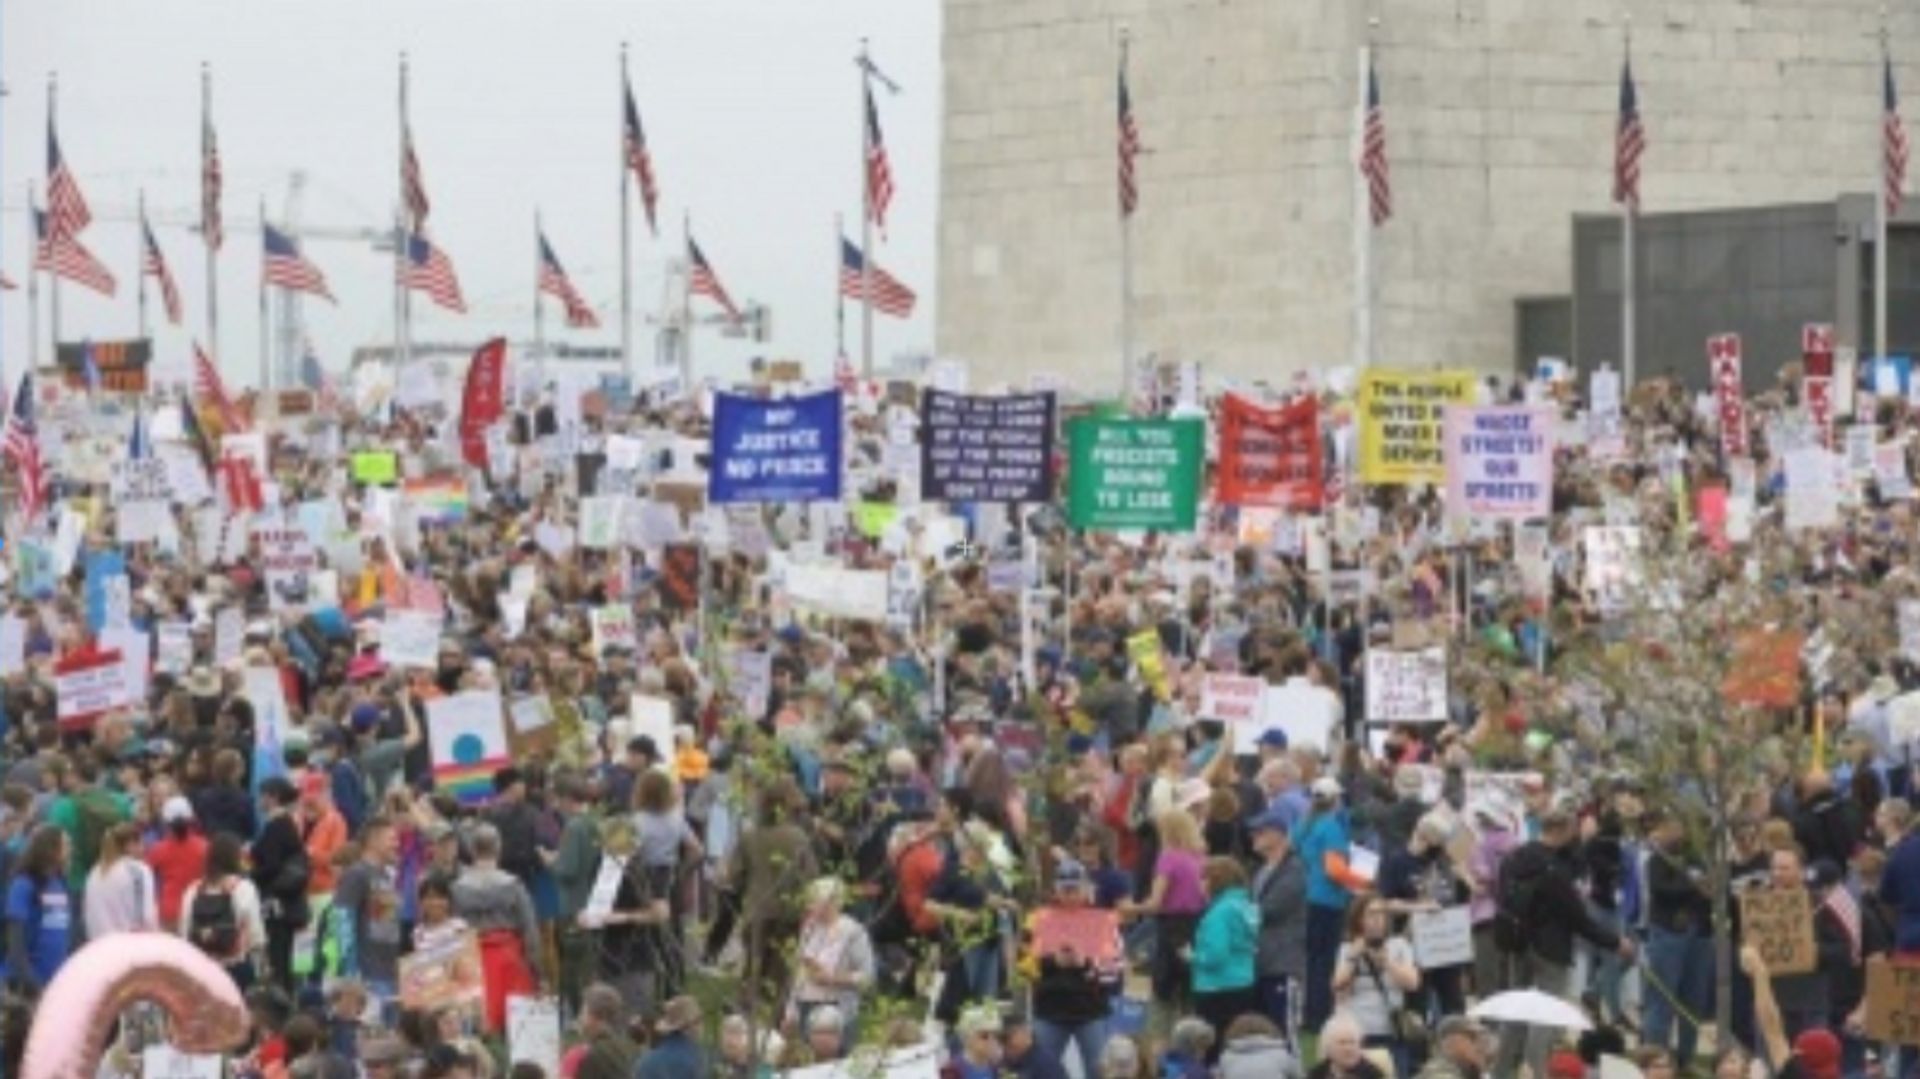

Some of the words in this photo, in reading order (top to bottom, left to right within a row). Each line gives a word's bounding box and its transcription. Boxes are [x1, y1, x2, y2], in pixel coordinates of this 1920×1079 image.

[764, 409, 796, 425] NO
[732, 429, 820, 451] JUSTICE
[1091, 447, 1179, 465] FASCISTS
[724, 457, 757, 479] NO
[760, 455, 828, 476] PEACE
[1485, 459, 1519, 477] OUR
[1103, 468, 1167, 486] BOUND
[1096, 491, 1119, 508] TO
[1127, 491, 1172, 508] LOSE
